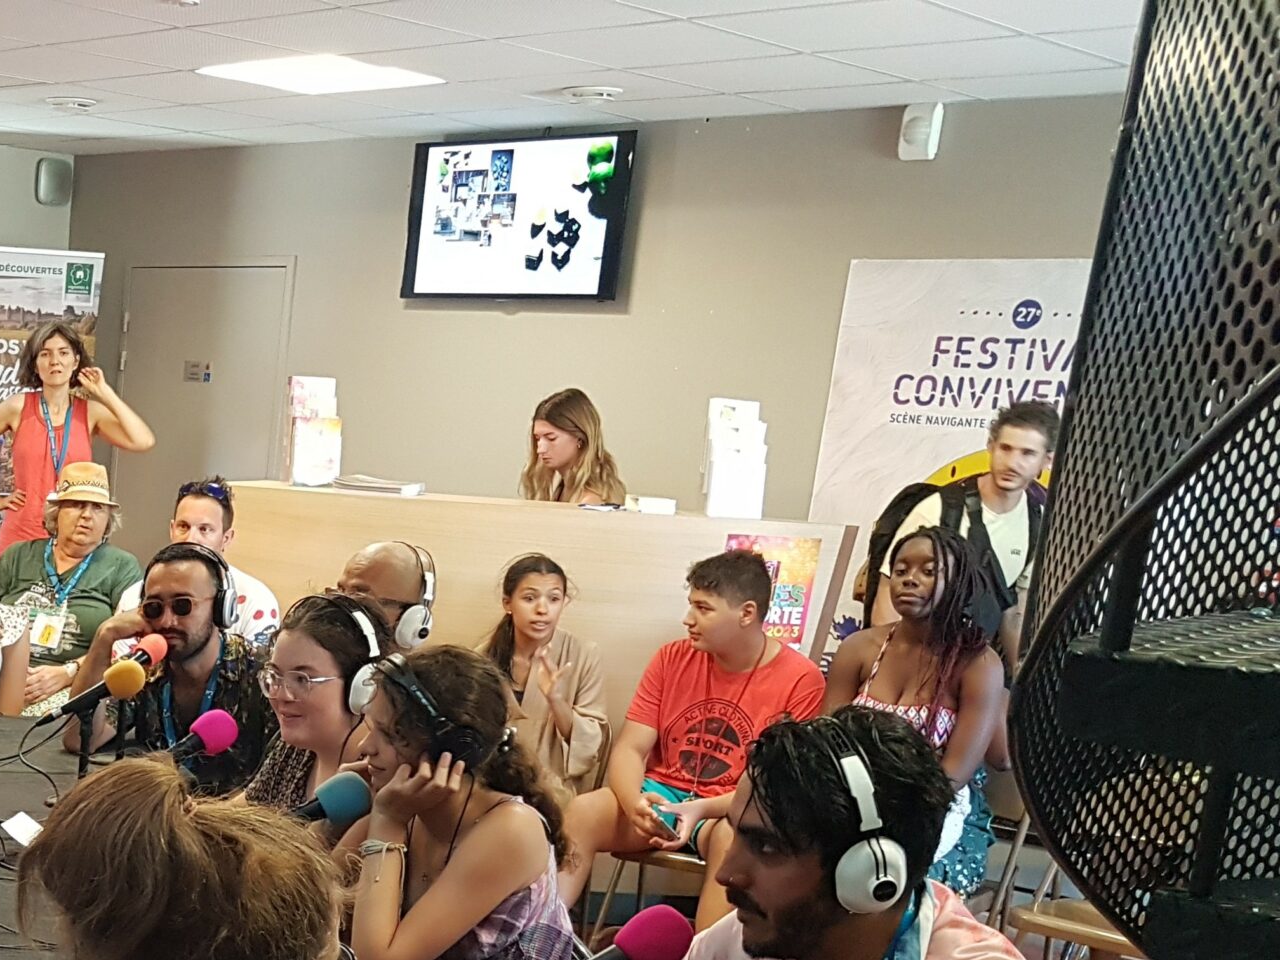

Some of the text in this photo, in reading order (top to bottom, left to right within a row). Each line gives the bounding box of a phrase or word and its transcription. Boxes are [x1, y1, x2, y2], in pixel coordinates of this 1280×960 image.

[889, 411, 922, 425] SCÈNE
[925, 414, 987, 429] NAVIGANTE
[765, 625, 800, 638] 2023
[685, 736, 734, 756] SPORT
